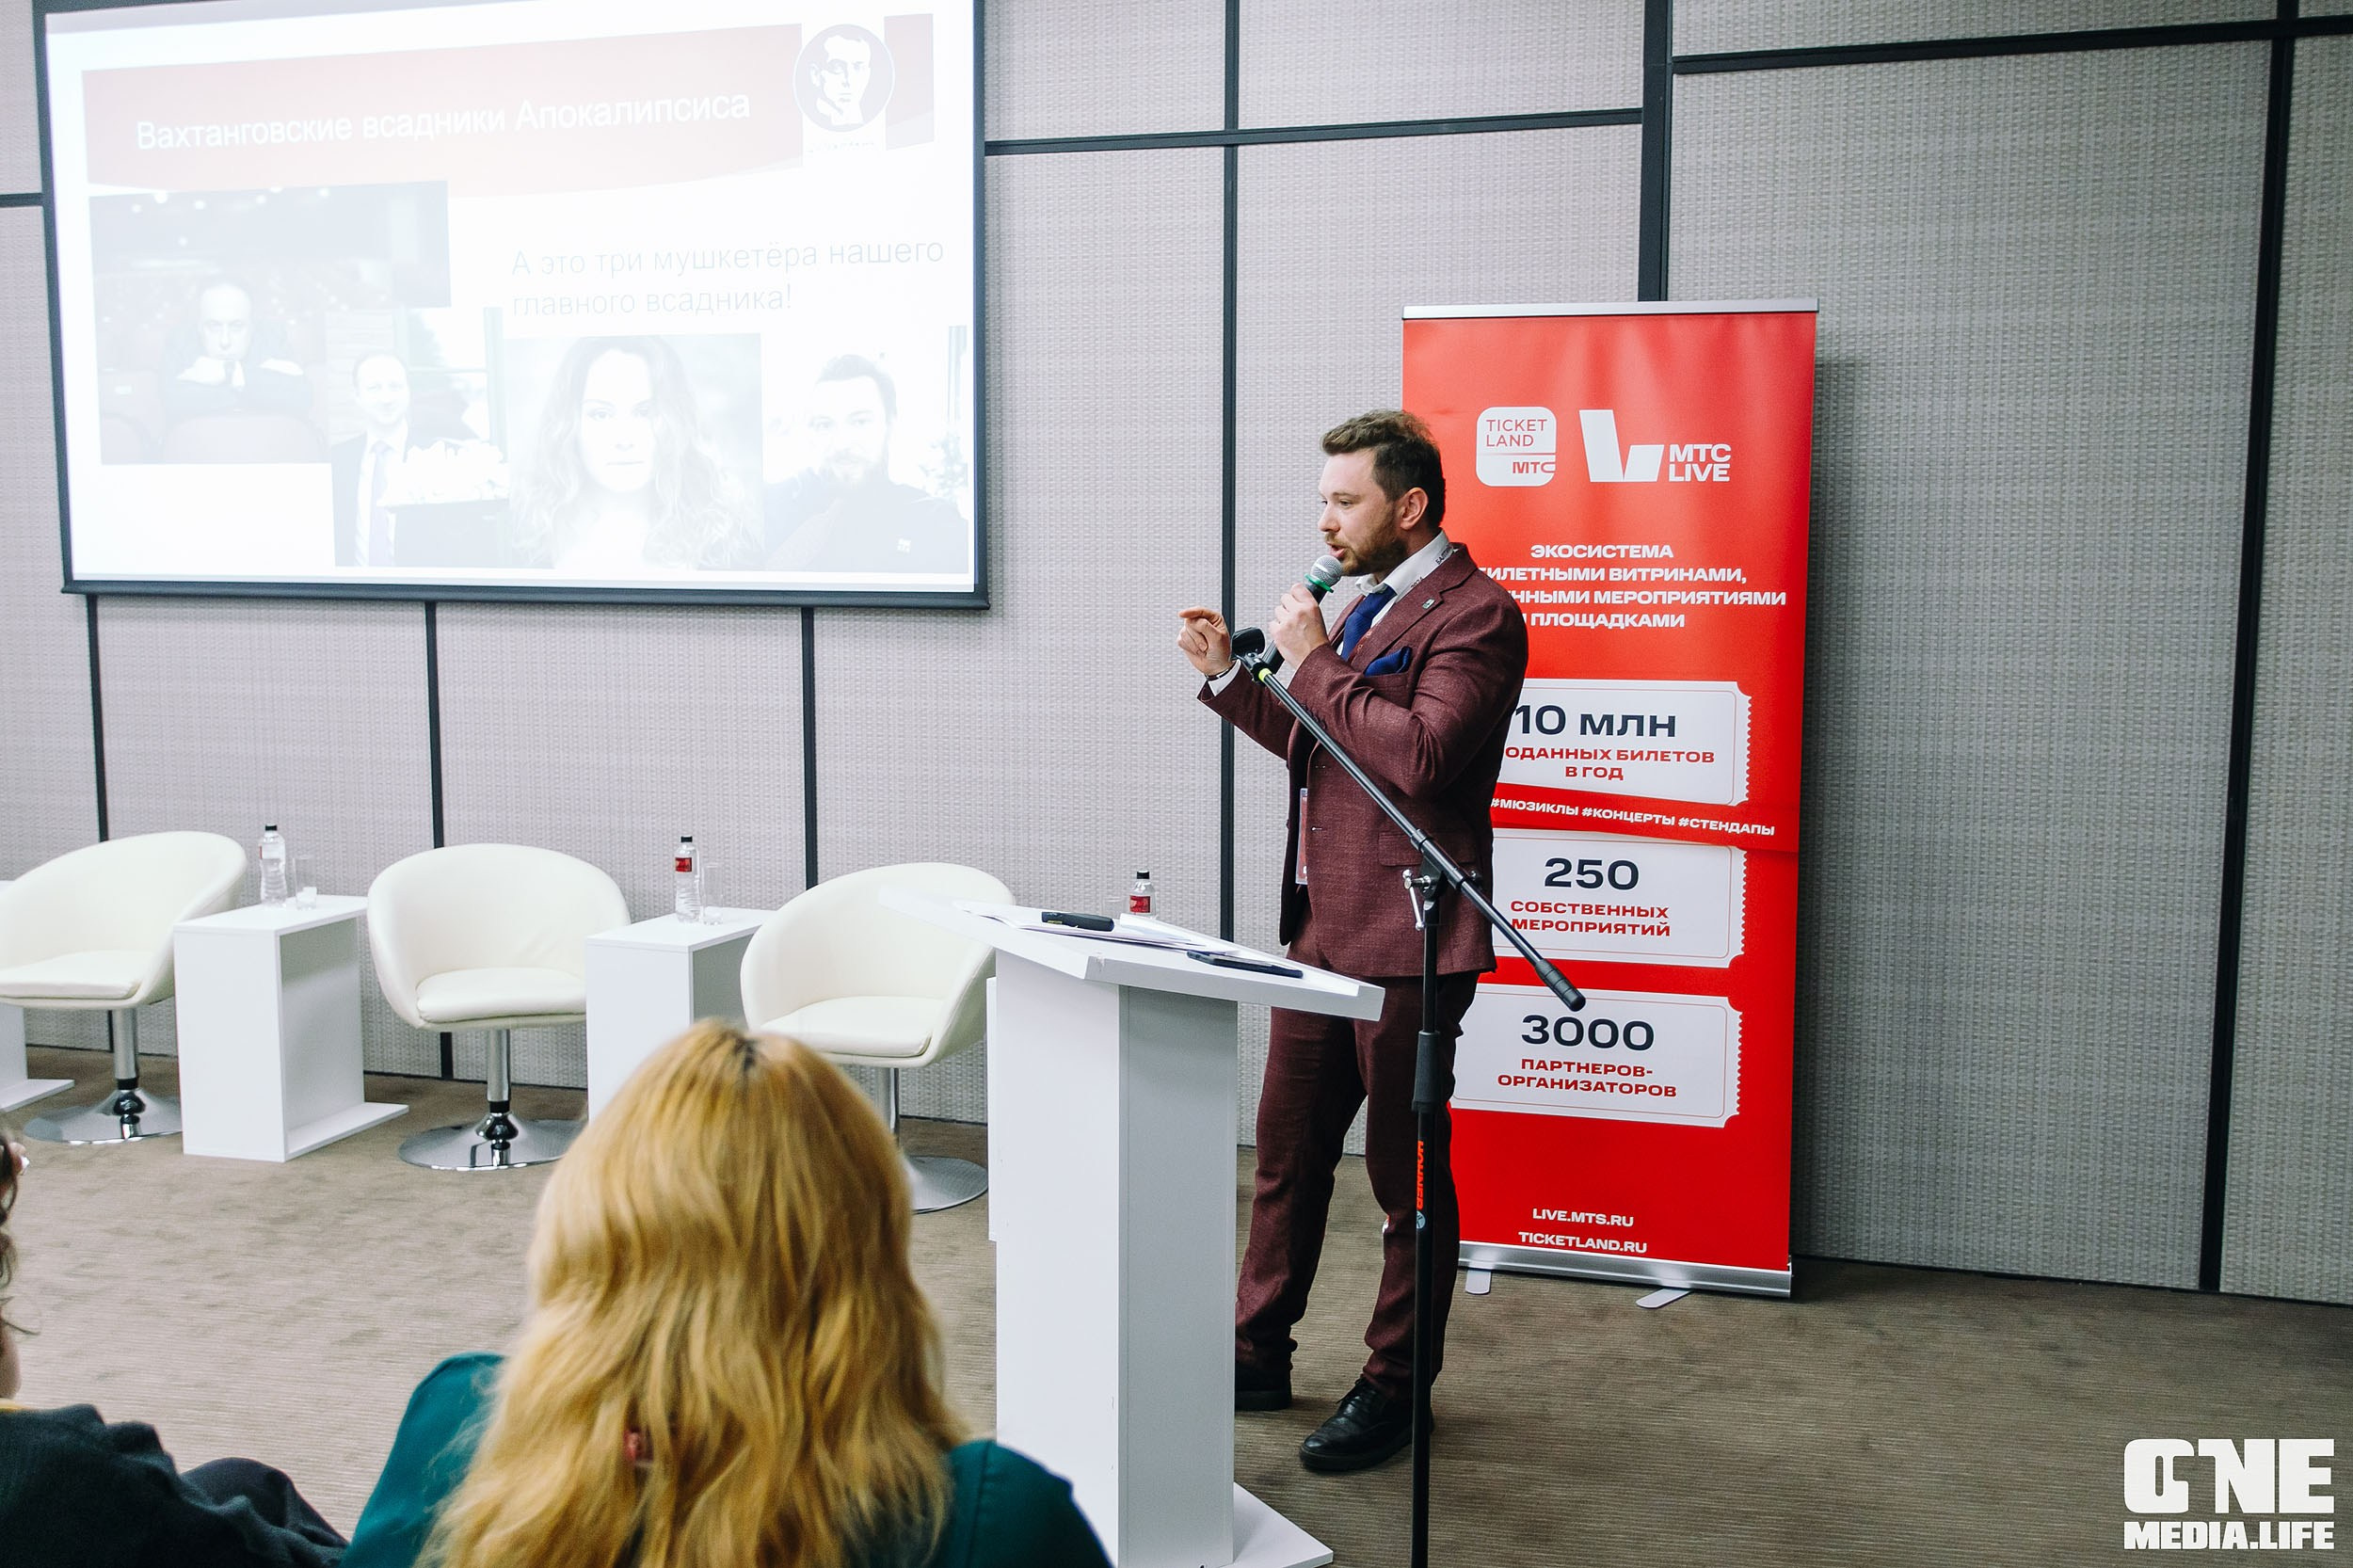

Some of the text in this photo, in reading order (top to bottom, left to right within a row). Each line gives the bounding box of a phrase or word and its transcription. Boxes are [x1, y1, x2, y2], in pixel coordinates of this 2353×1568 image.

[136, 94, 751, 150] Вахтанговские всадники Апокалипсиса
[512, 241, 944, 279] А это три мушкетёра нашего
[513, 283, 792, 316] главного всадника!
[1486, 419, 1547, 432] TICKET
[1486, 435, 1534, 447] LAND
[1669, 463, 1730, 482] LIVE
[1530, 544, 1674, 559] ЭКОСИСТЕМА
[1609, 568, 1747, 584] ВИТРИНАМИ,
[1507, 590, 1786, 606] ННЫМИ МЕРОПРИЯТИЯМИ
[1530, 613, 1685, 630] ПЛОЩАДКАМИ
[1514, 704, 1566, 735] 10
[1505, 746, 1715, 764] ОДАННЫХ БИЛЕТОВ
[1565, 766, 1624, 780] В ГОД
[1491, 797, 1775, 836] #МЮЗИКЛЫ #КОНЦЕРТЫ #СТЕНДАПЫ
[1545, 857, 1640, 890] 250
[1511, 900, 1669, 919] СОБСТВЕННЫХ
[1512, 919, 1671, 936] МЕРОПРИЯТИЙ
[1521, 1015, 1655, 1051] 3000
[1521, 1058, 1653, 1078] ПАРТНЕРОВ-
[1497, 1074, 1677, 1097] ОРГАНИЗАТОРОВ
[1532, 1208, 1634, 1227] LIVE.MTS.RU
[1518, 1231, 1647, 1254] TICKETLAND.RU
